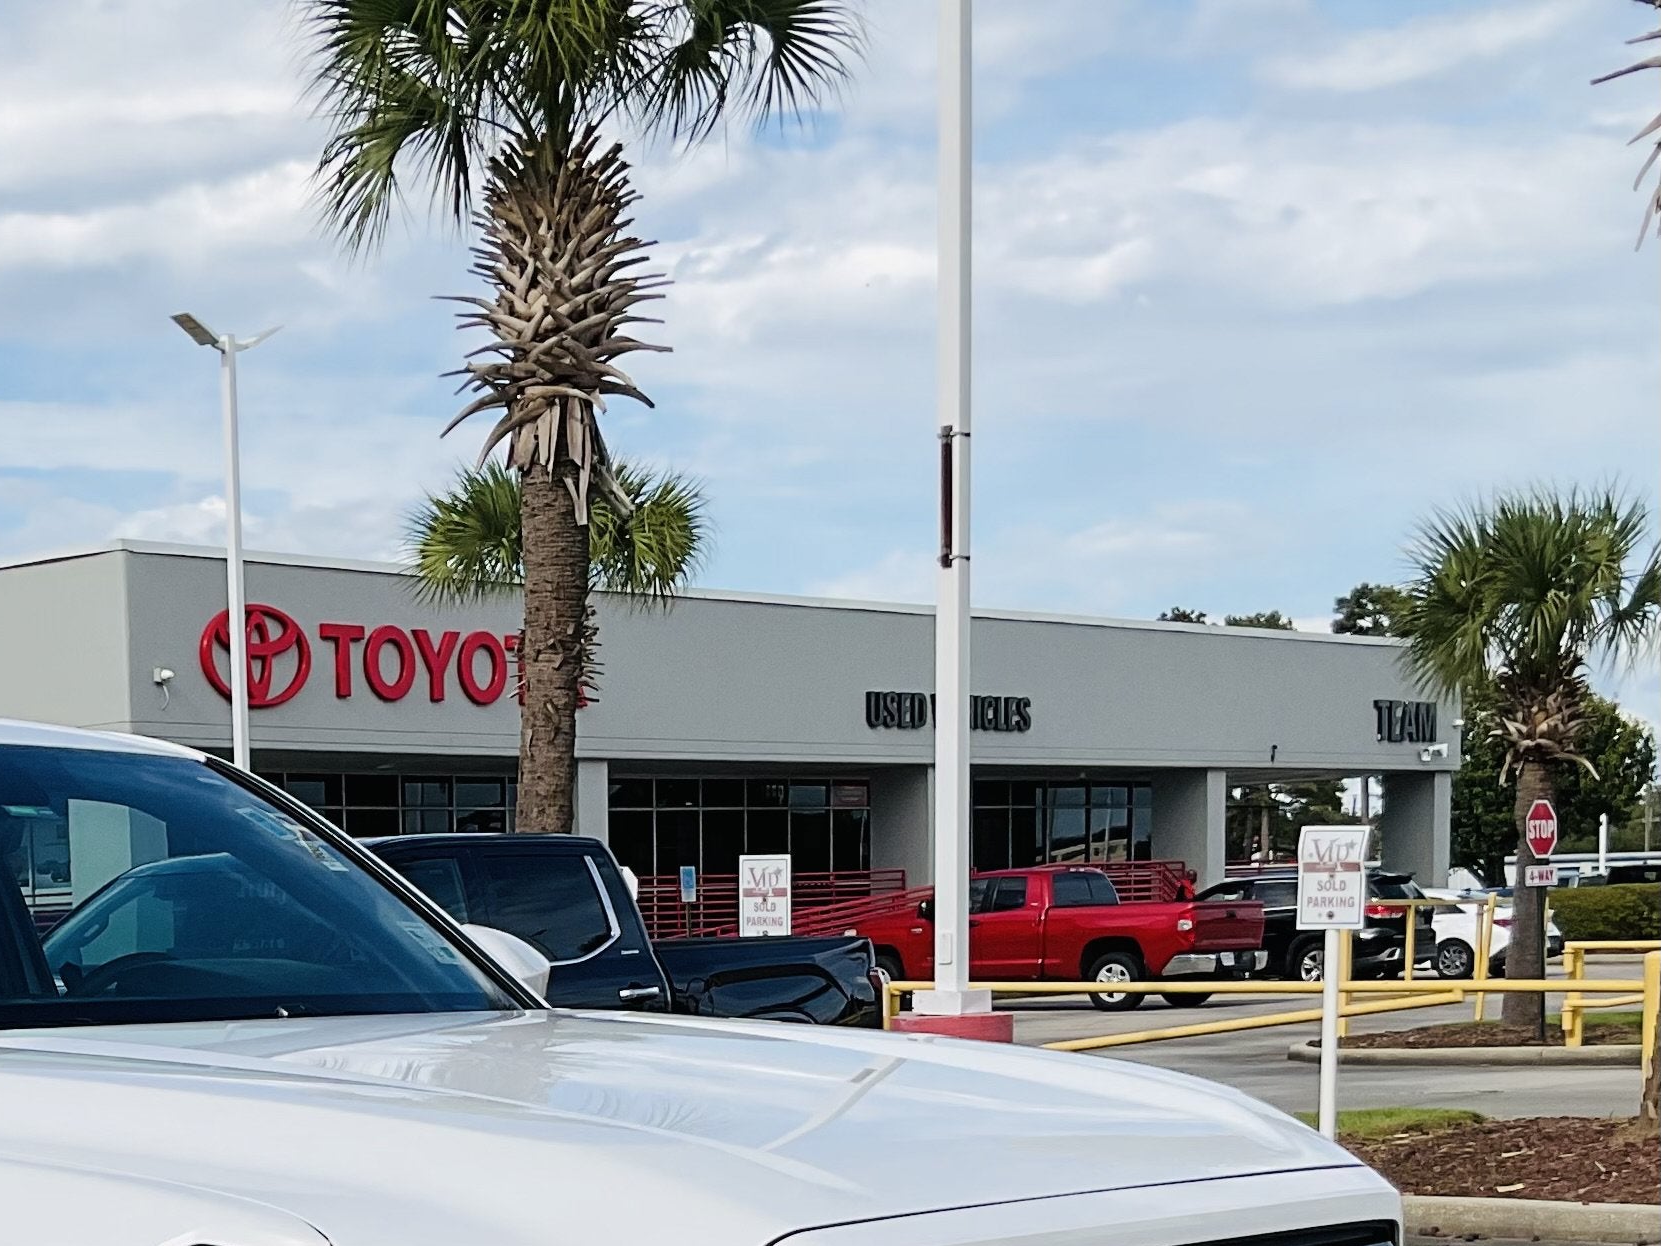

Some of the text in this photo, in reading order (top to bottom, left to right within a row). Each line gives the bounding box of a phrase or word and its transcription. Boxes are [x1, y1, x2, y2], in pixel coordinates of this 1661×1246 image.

[319, 623, 588, 708] TOYO
[865, 691, 1032, 732] USED ICLES
[1373, 700, 1437, 742] TEAM
[1529, 820, 1554, 839] STOP
[1530, 869, 1554, 882] 4-WAY
[1317, 880, 1347, 891] SOLD
[753, 902, 777, 912] SOLD
[1307, 896, 1355, 907] PARKING
[747, 916, 784, 927] PARKING
